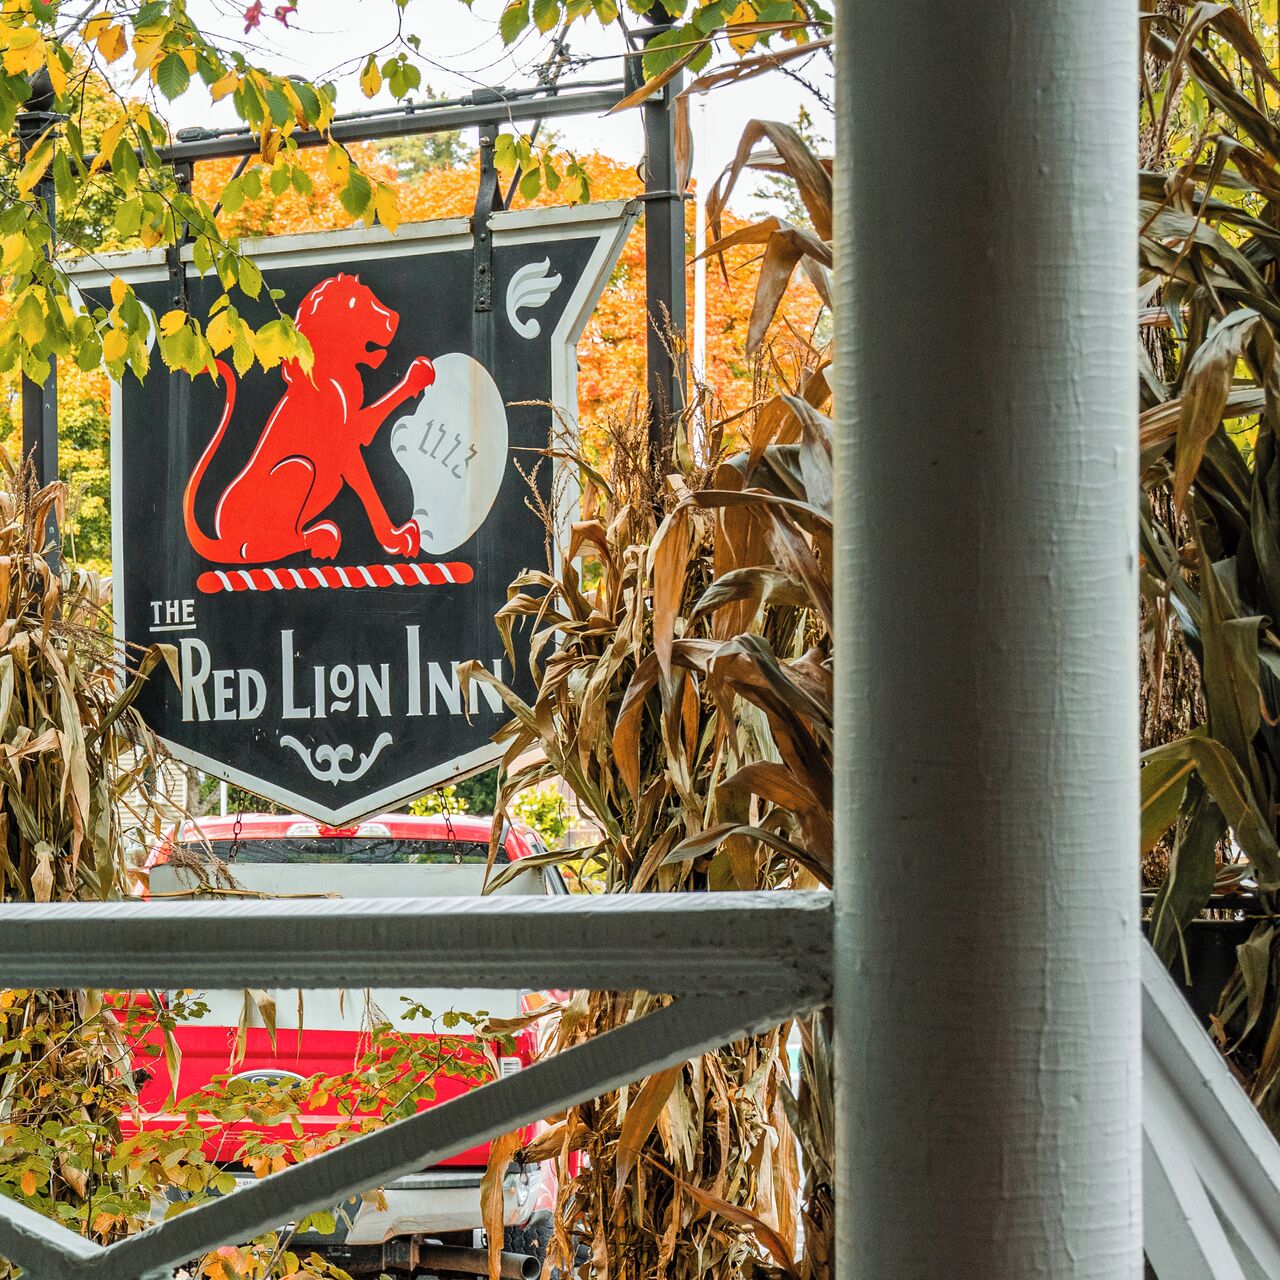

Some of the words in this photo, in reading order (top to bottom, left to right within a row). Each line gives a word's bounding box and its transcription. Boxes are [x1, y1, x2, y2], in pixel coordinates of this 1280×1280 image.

[150, 599, 196, 625] THE
[179, 638, 267, 722] RED
[280, 629, 392, 719] LION
[405, 625, 505, 717] INN
